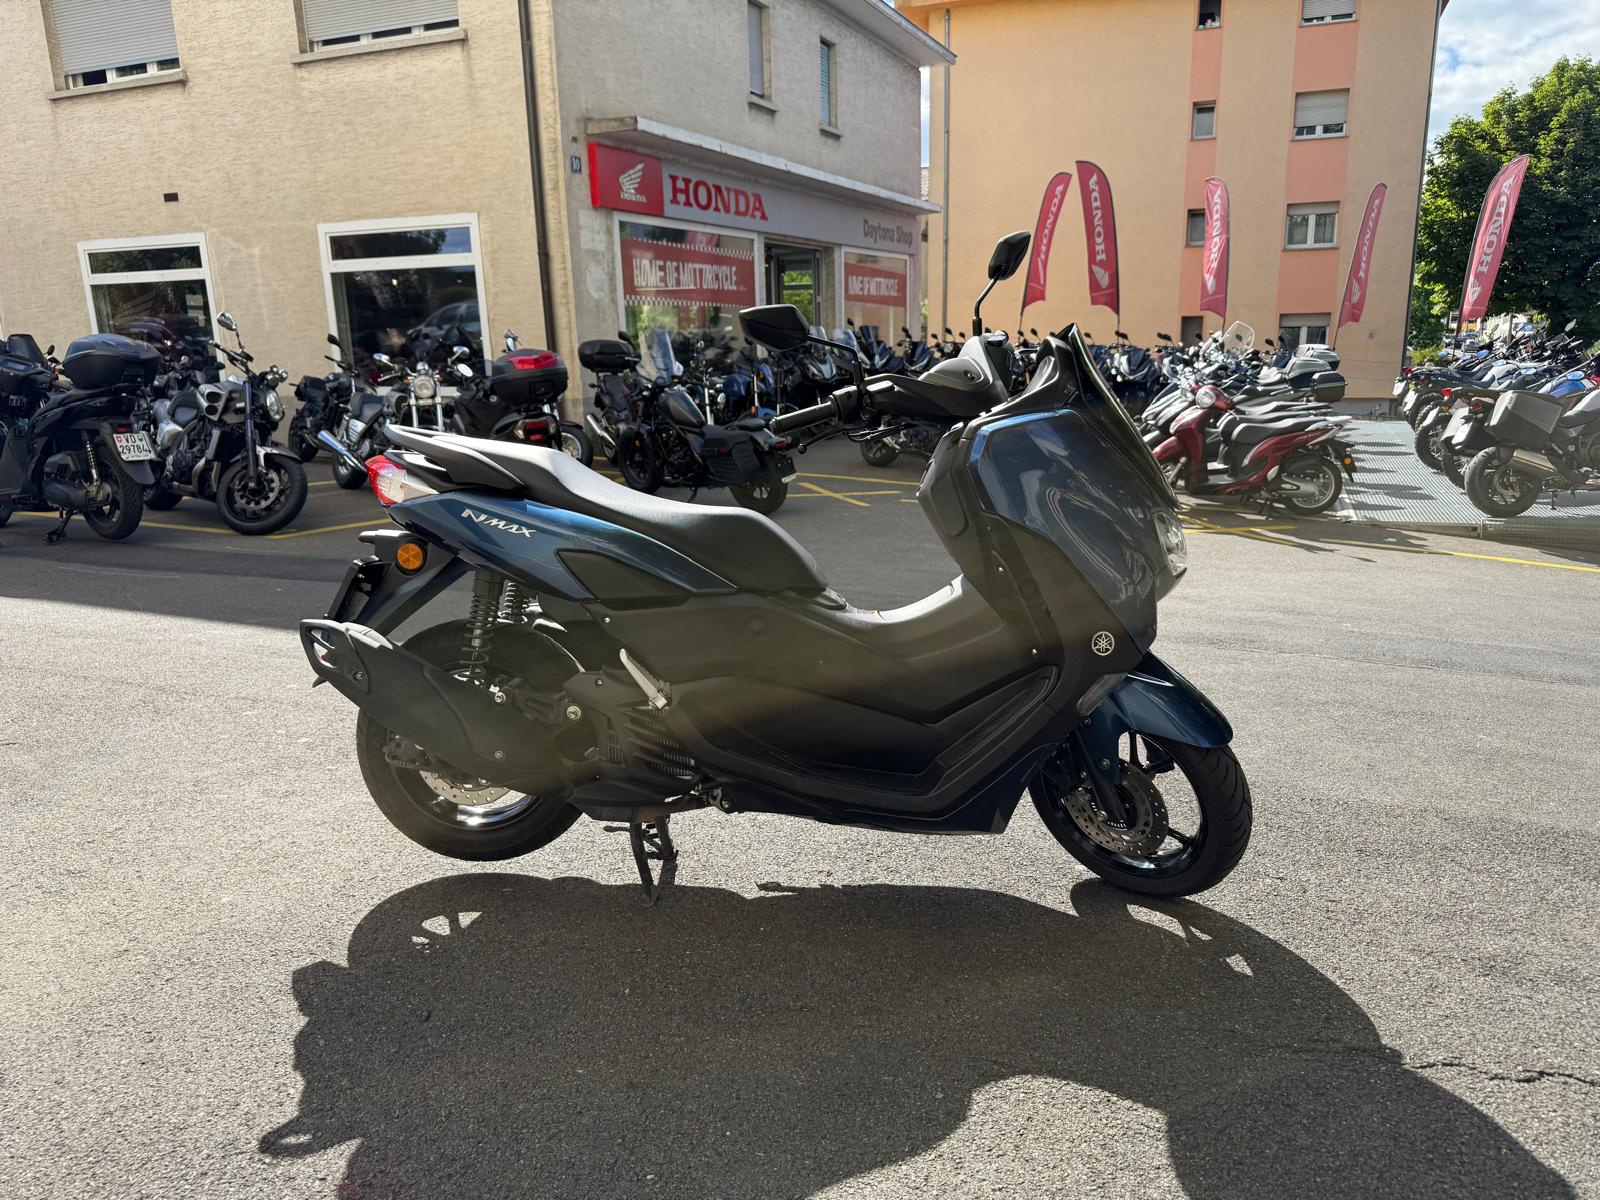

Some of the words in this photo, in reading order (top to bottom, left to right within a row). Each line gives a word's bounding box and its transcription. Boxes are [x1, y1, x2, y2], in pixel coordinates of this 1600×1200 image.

[620, 191, 648, 203] HONDA
[668, 174, 768, 221] HONDA
[863, 218, 895, 244] Daytona
[896, 225, 913, 248] Shop
[1040, 183, 1064, 262] HONDA
[1089, 173, 1106, 262] HONDA
[1477, 175, 1515, 274] HONDA
[1358, 199, 1381, 281] HONDA
[633, 257, 665, 287] HOME
[666, 260, 678, 288] OF
[120, 445, 148, 454] 29784
[123, 434, 136, 443] VD
[461, 508, 536, 538] NMAX
